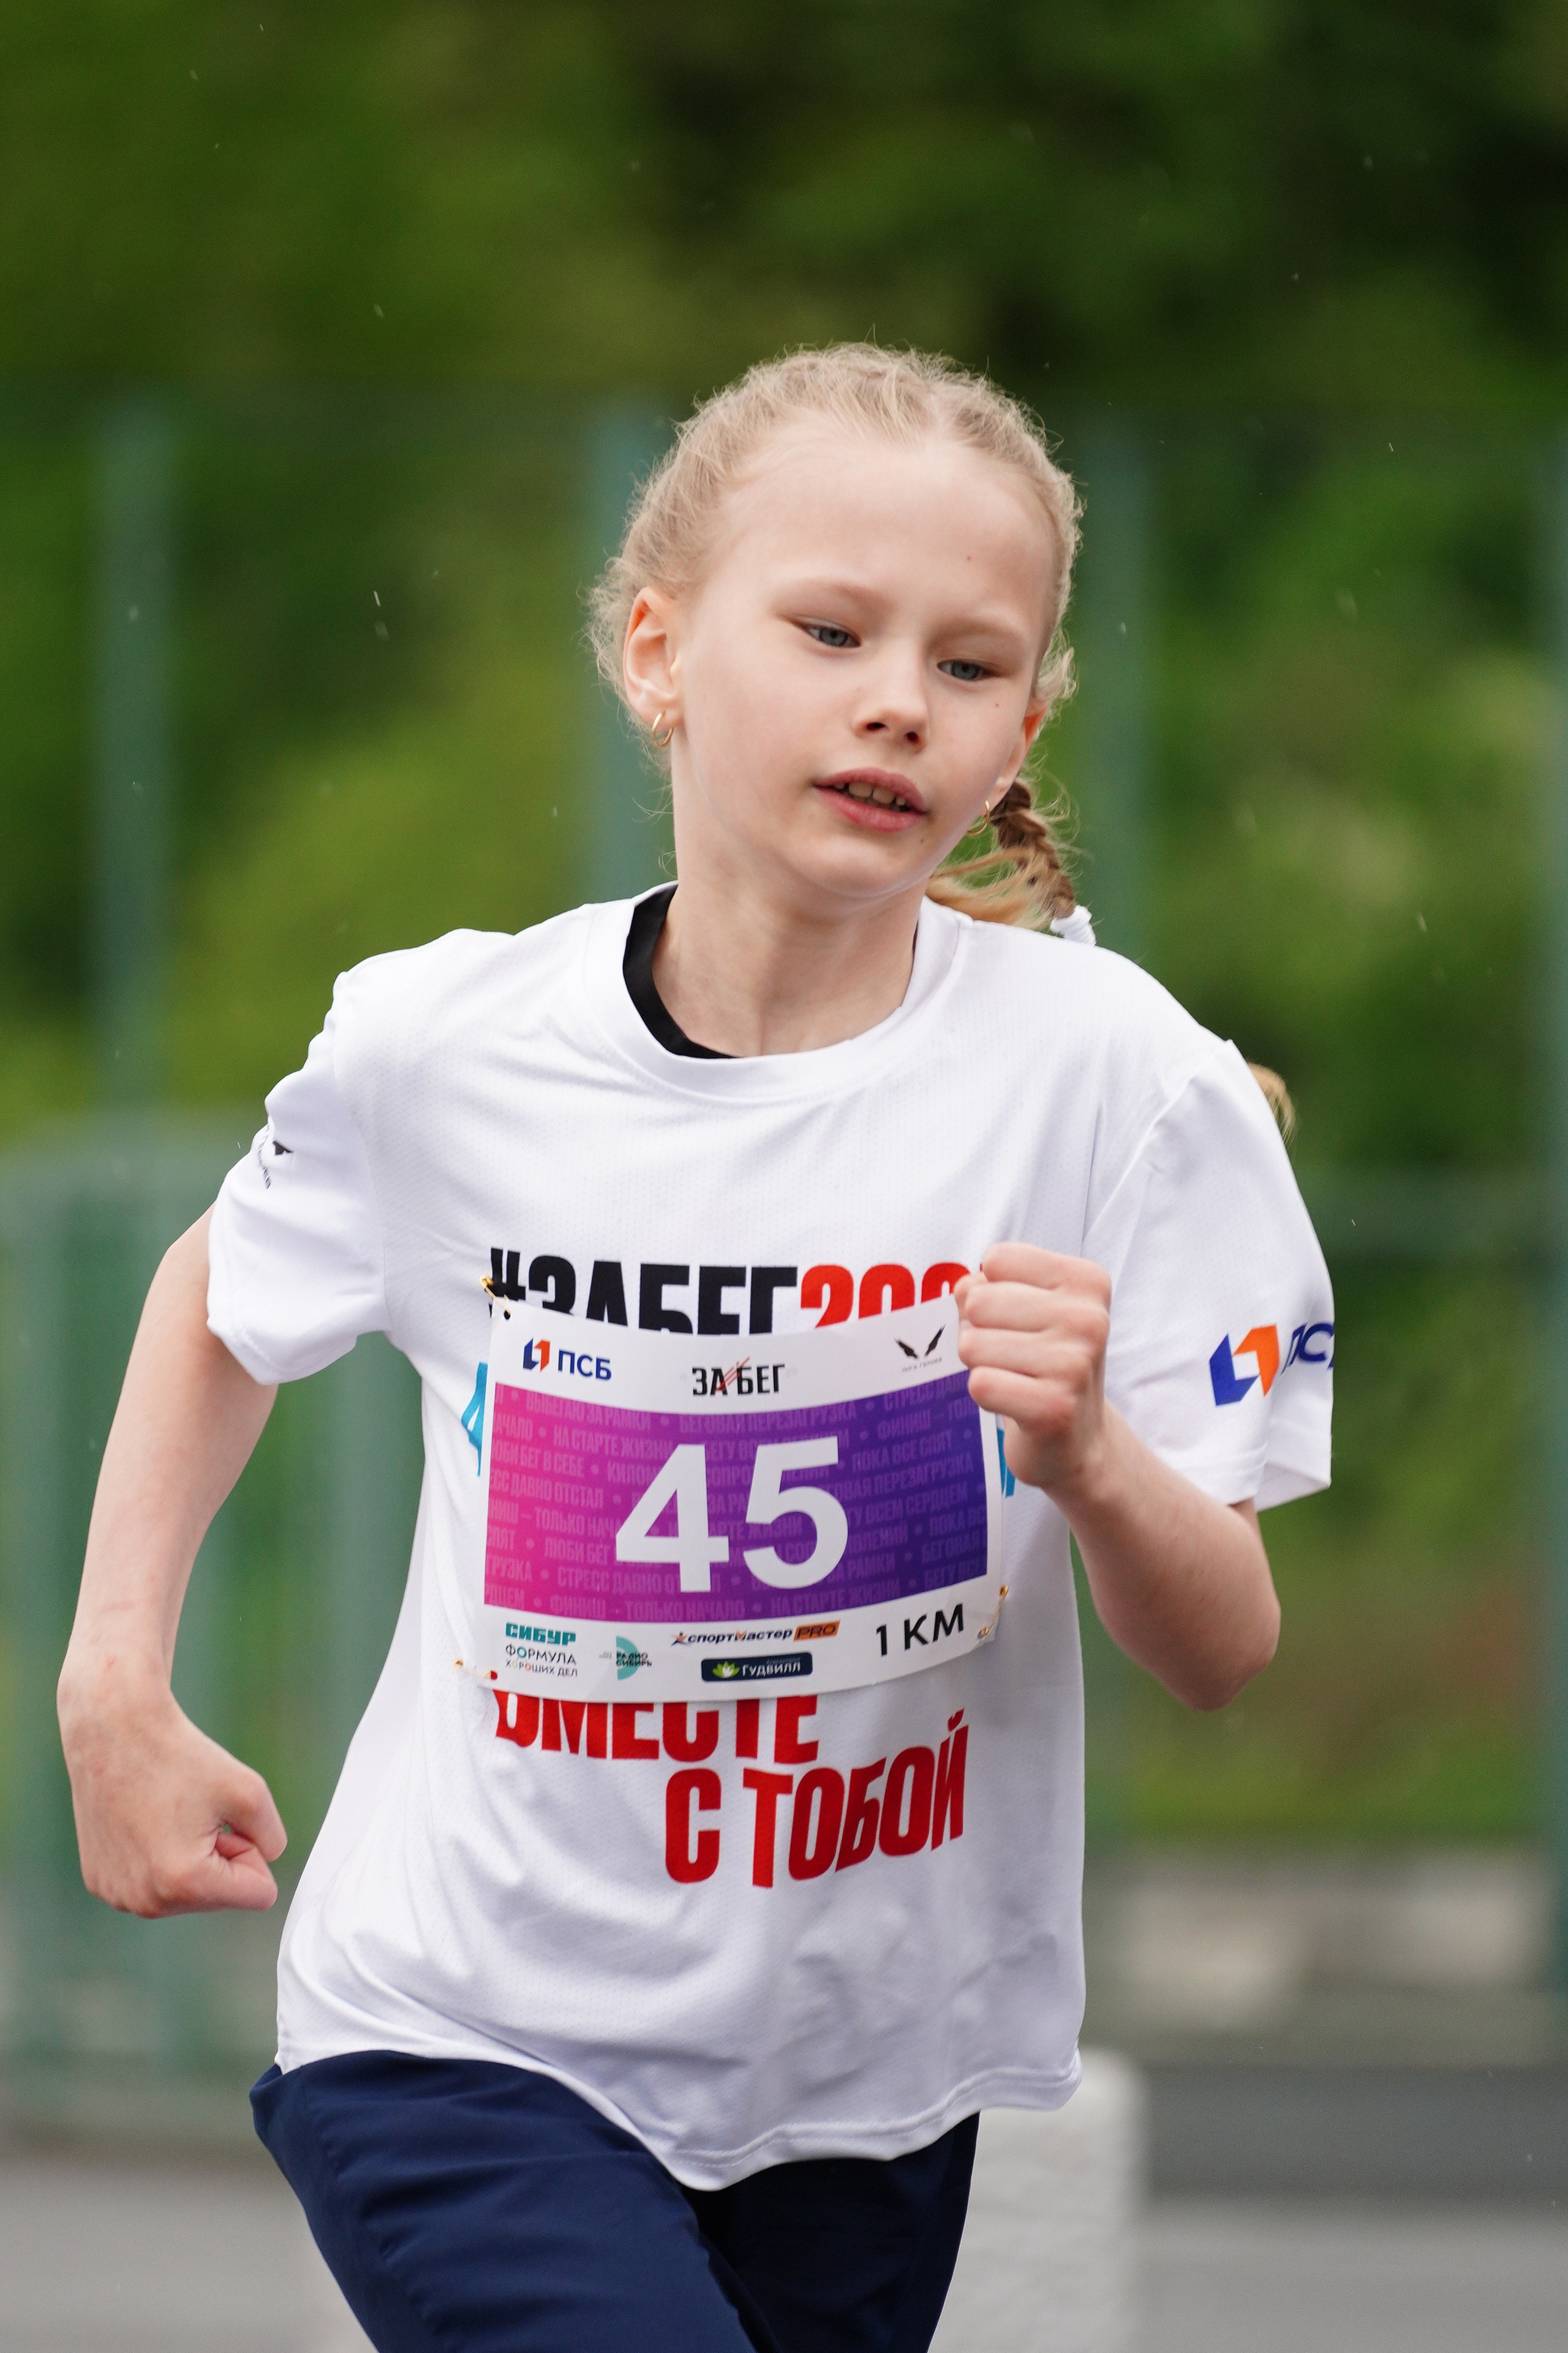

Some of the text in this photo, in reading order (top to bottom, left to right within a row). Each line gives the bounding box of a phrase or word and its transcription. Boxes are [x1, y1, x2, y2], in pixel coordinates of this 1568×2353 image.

[557, 1348, 612, 1381] ПСБ
[1280, 1321, 1334, 1376] ПС
[616, 1435, 849, 1593] 45
[506, 1622, 576, 1647] СИБУР
[797, 1623, 836, 1639] PRO
[876, 1602, 965, 1657] 1 КМ
[506, 1644, 577, 1665] ФОРМУЛА
[665, 1708, 970, 1889] С ТОБОЙ
